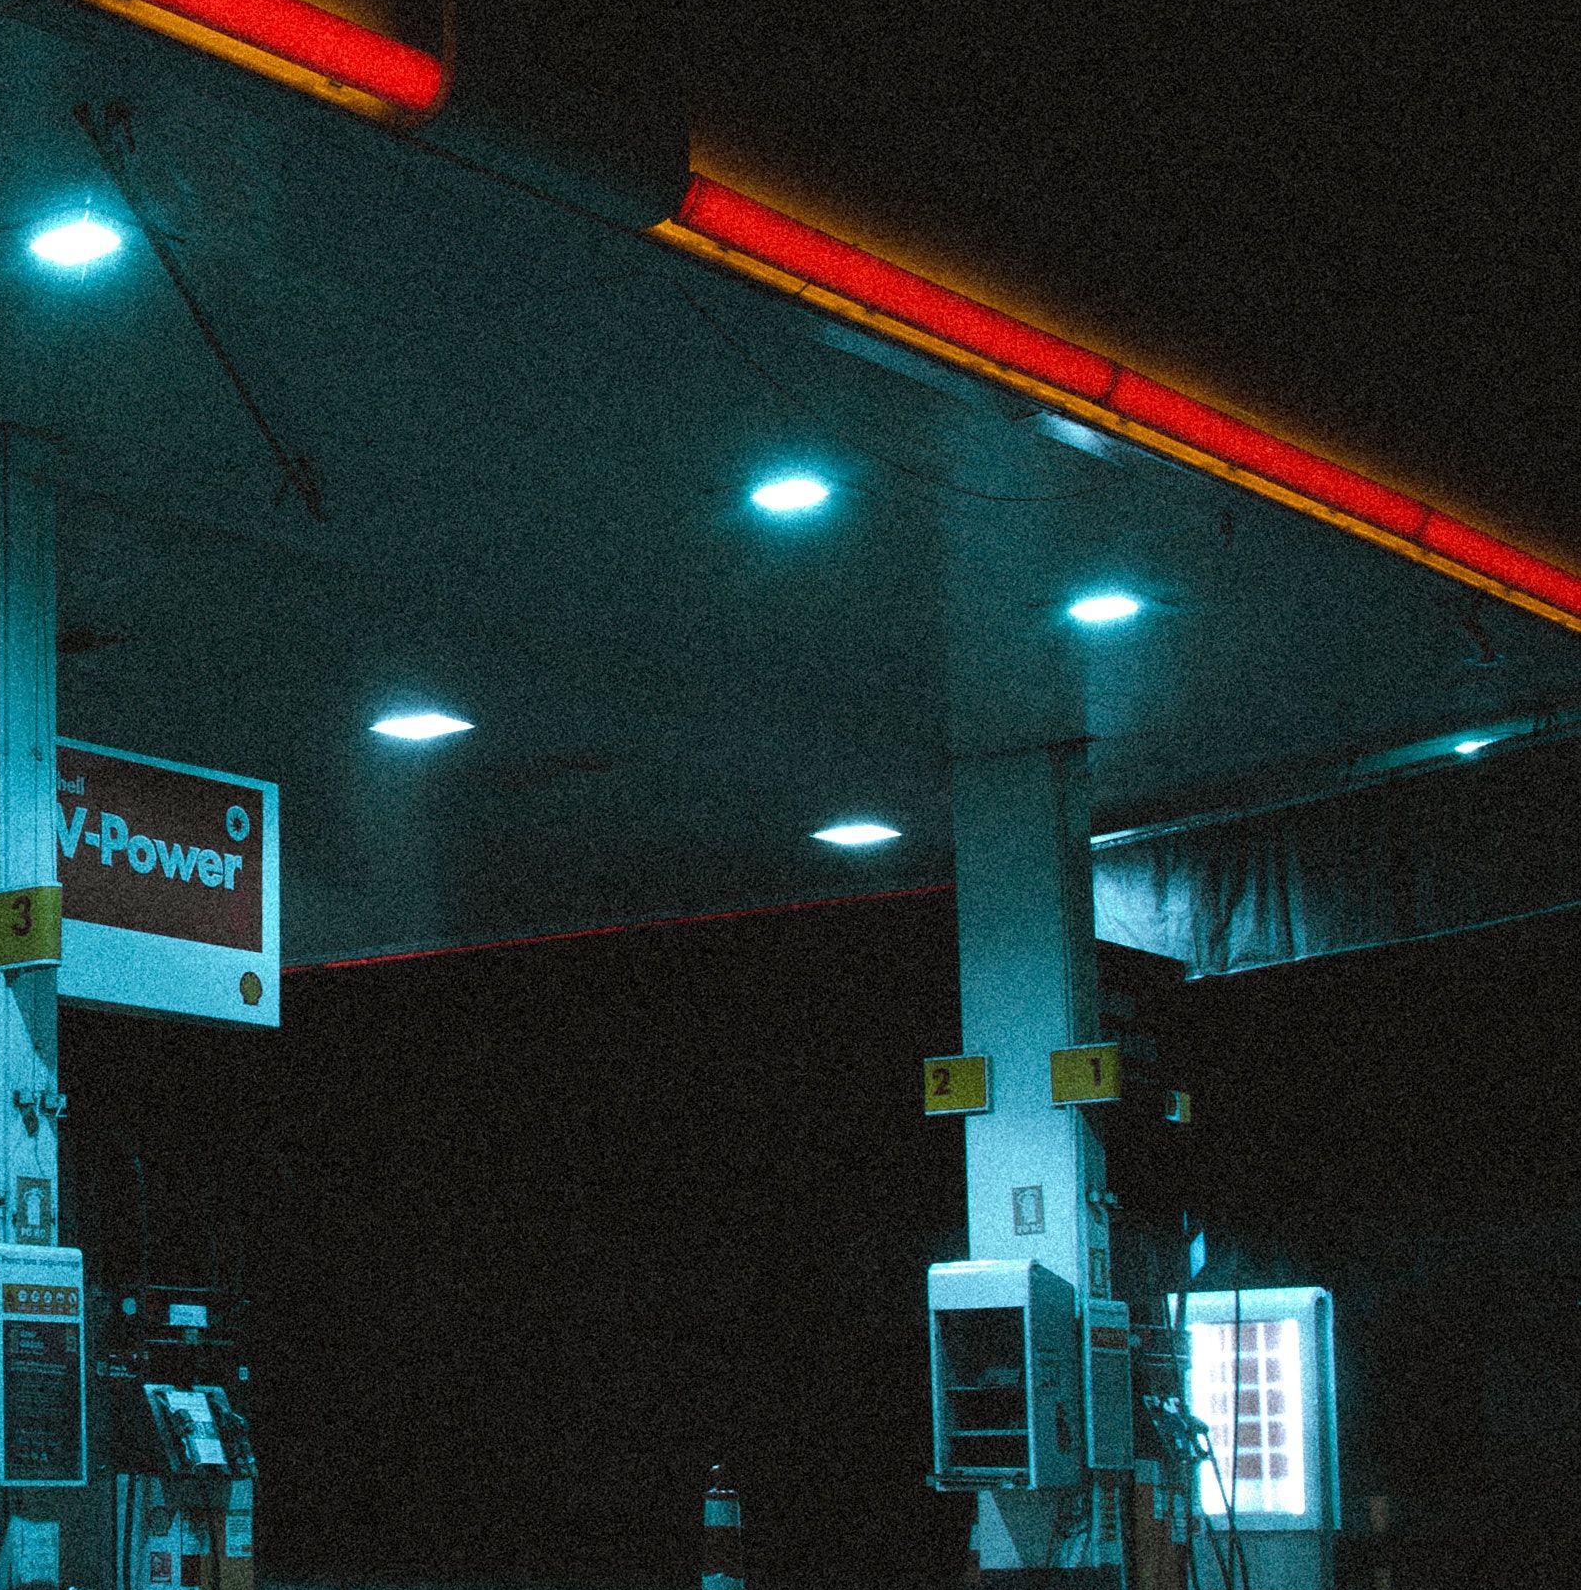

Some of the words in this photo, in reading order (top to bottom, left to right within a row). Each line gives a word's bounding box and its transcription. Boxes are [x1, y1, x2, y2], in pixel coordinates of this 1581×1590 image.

[57, 772, 87, 797] hell
[57, 801, 244, 891] V-Power
[11, 895, 34, 938] 3
[931, 1066, 952, 1096] 2
[1089, 1056, 1102, 1087] 1
